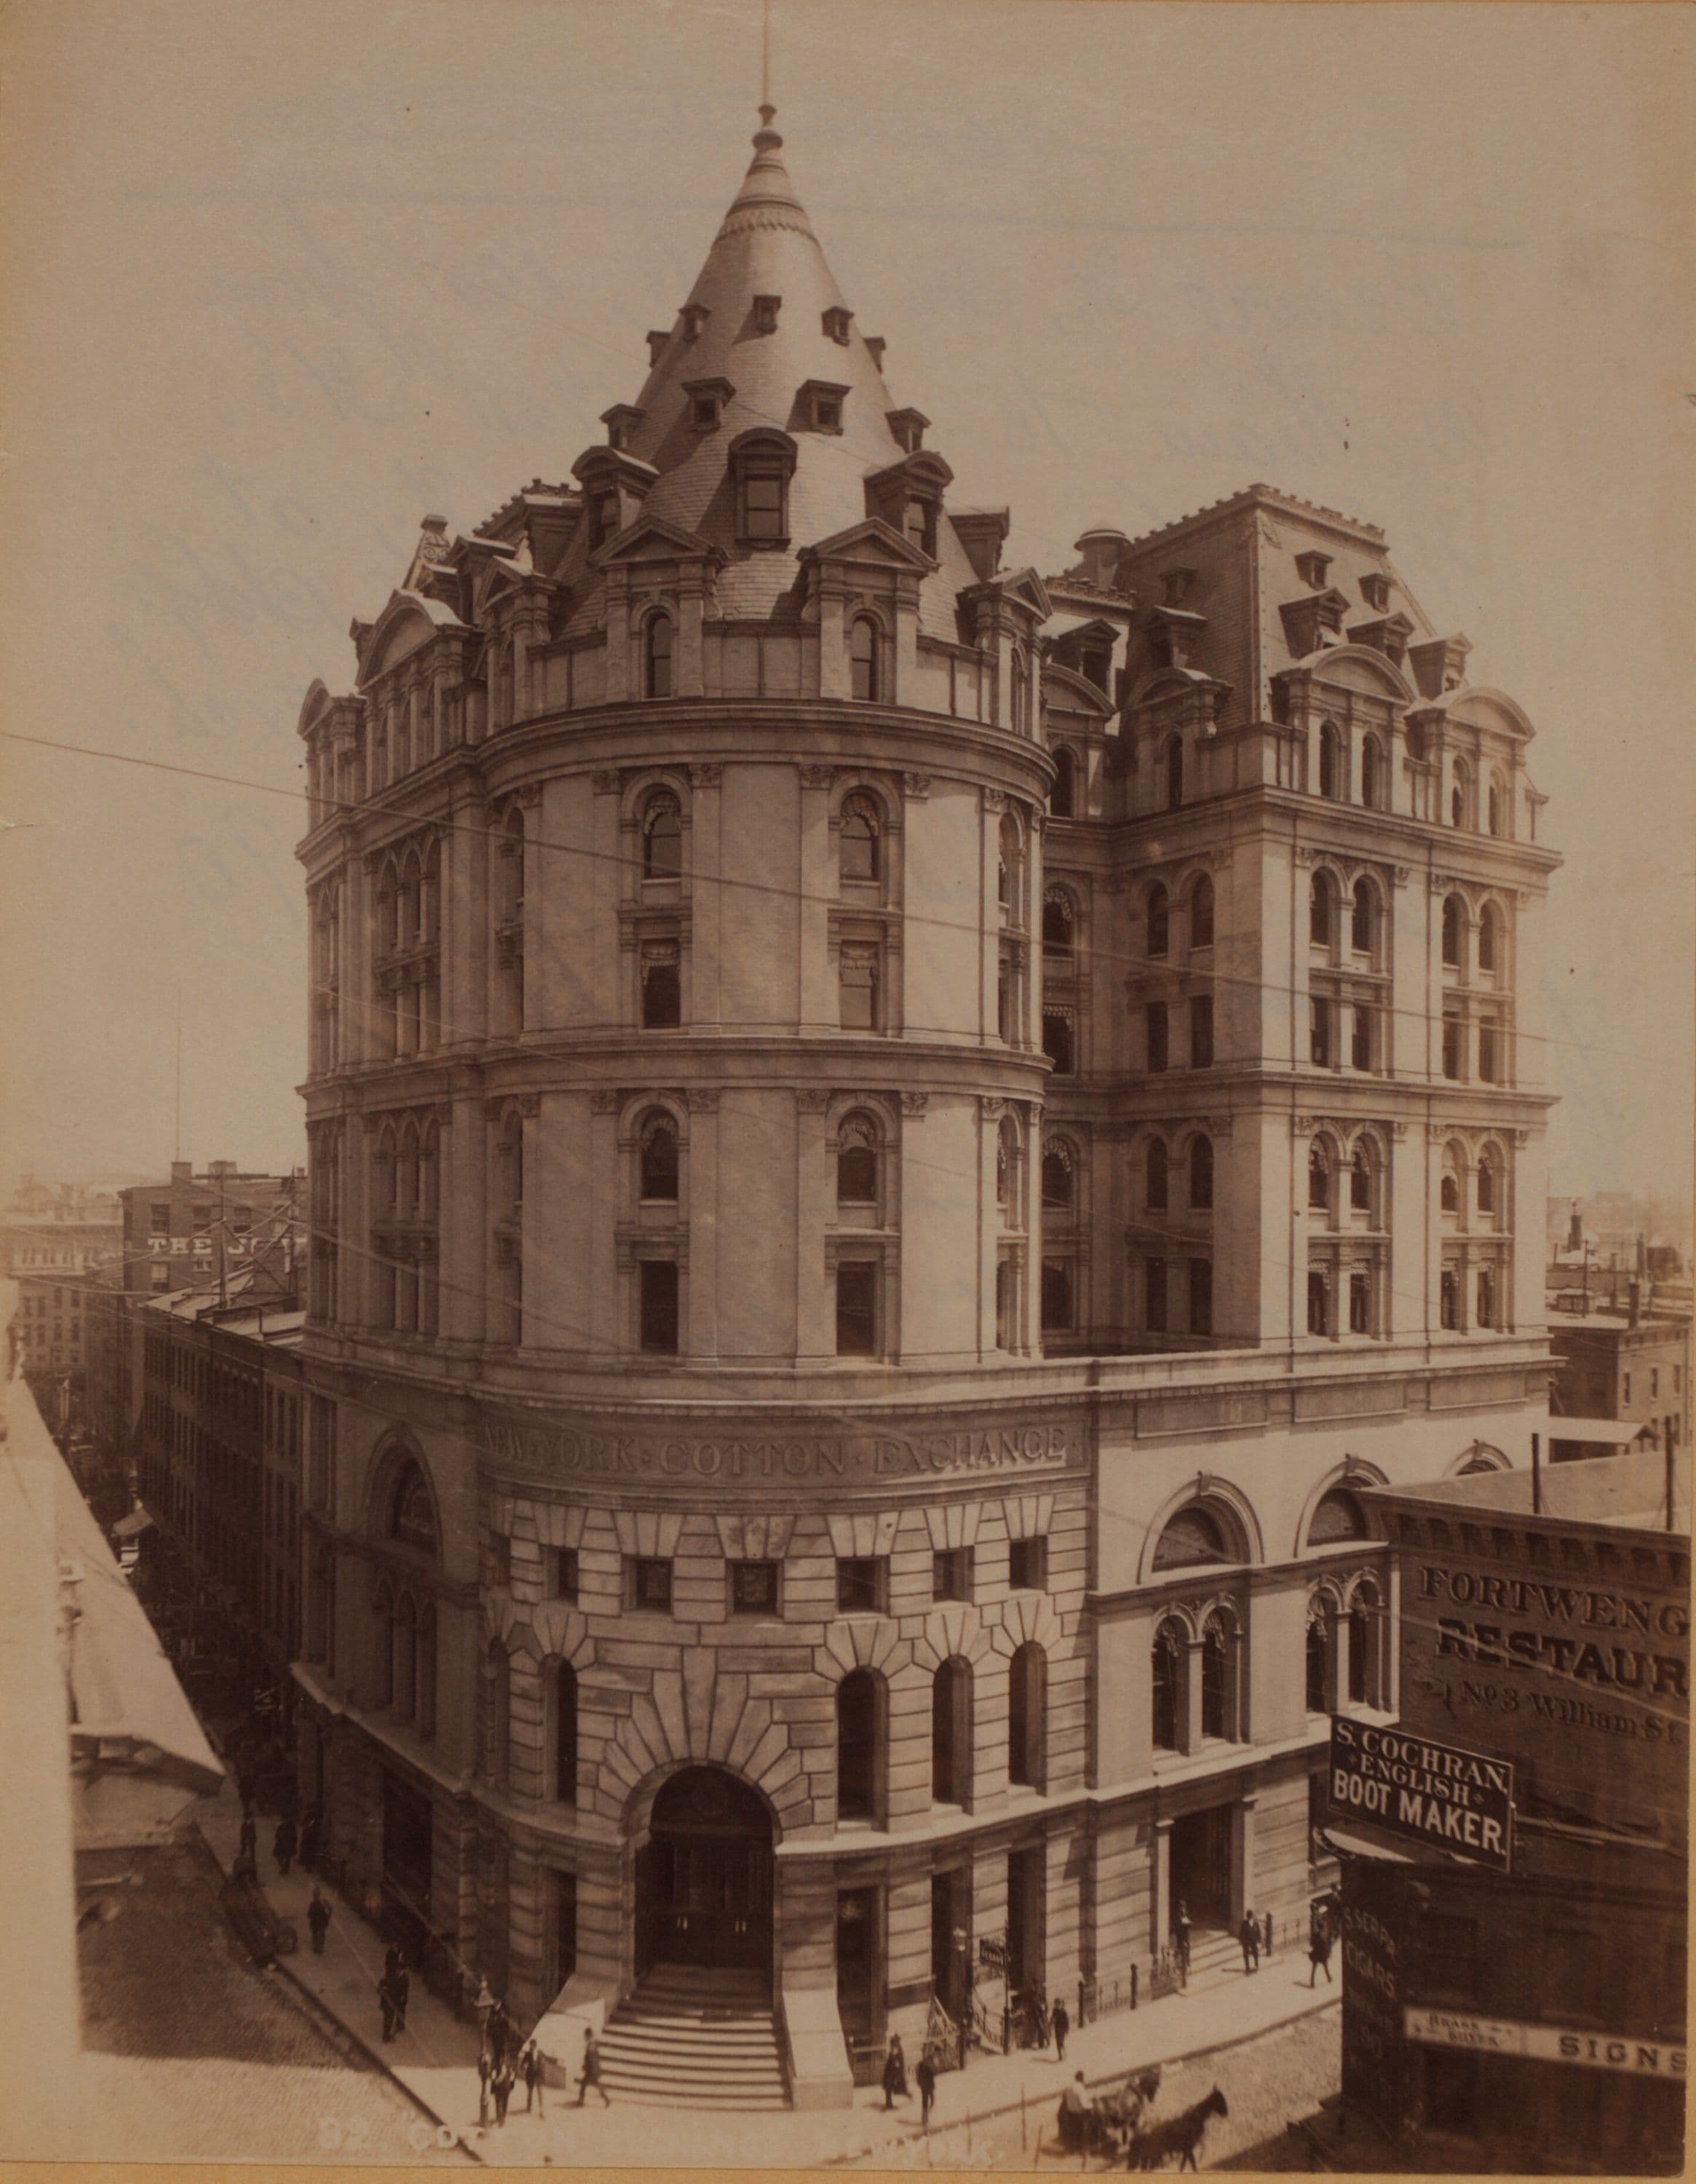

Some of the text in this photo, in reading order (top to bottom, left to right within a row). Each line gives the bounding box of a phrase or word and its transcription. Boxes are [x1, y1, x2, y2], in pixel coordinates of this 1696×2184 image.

[148, 1237, 213, 1254] THE
[540, 1431, 638, 1471] YORK
[659, 1441, 847, 1476] COTTON
[1336, 1722, 1357, 1747] S.
[1360, 1752, 1470, 1807] ENGLISH
[1333, 1768, 1507, 1856] BOOT MAKER.
[1347, 1939, 1397, 2000] CIGARS
[1558, 2035, 1687, 2072] SIGNS
